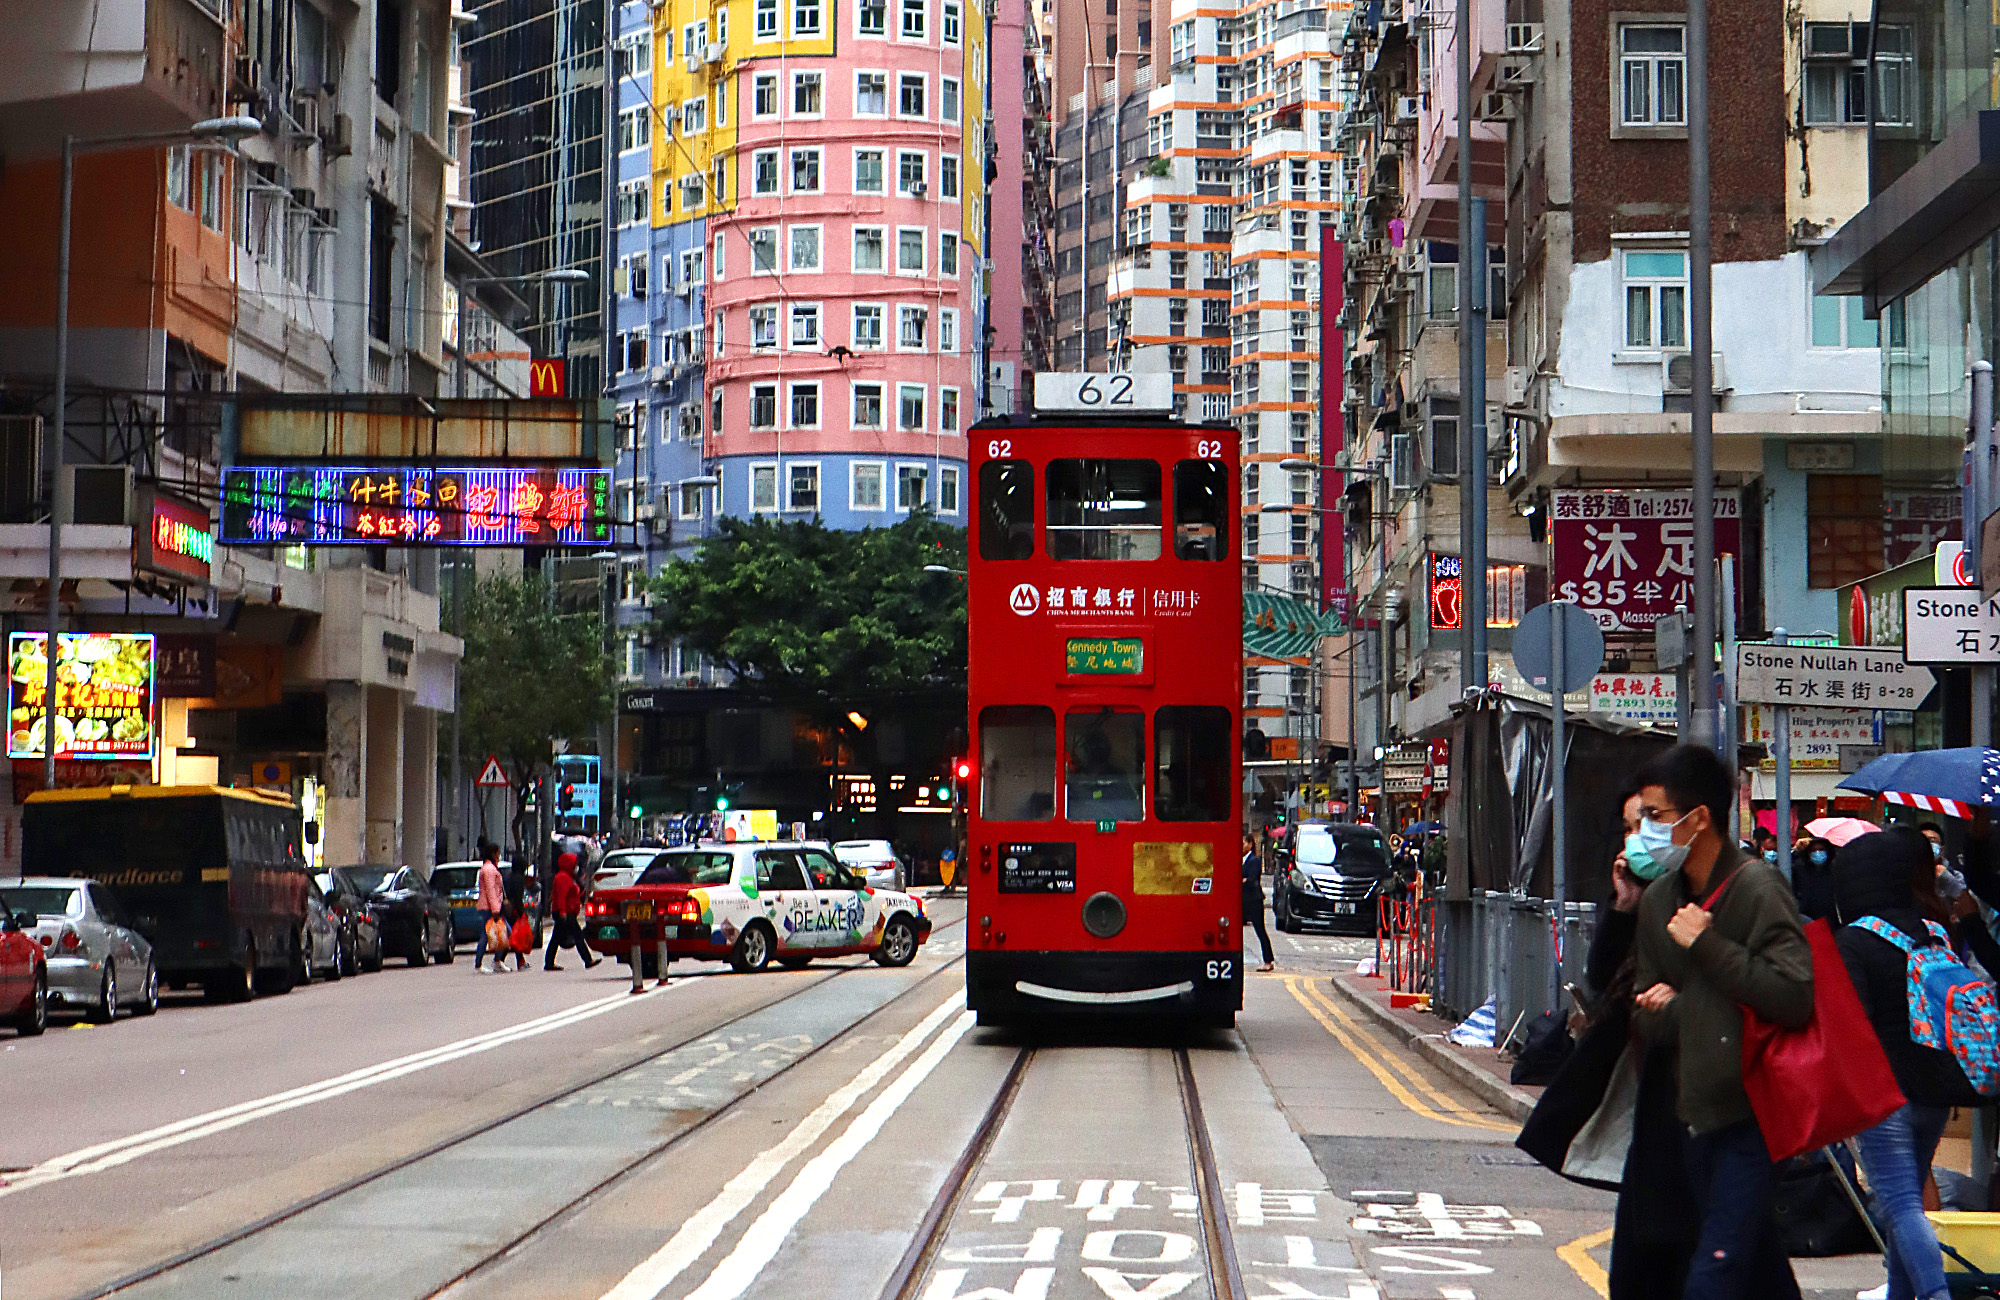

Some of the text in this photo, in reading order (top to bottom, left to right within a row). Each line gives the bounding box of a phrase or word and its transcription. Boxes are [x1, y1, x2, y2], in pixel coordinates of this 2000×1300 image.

[1078, 375, 1135, 406] 62
[988, 440, 1012, 458] 62
[1197, 440, 1222, 458] 62
[1556, 495, 1631, 517] 泰舒適
[1435, 556, 1460, 578] $98
[1047, 586, 1136, 608] 招商銀行
[1153, 589, 1201, 609] 信用卡
[1046, 609, 1135, 617] CHINA MERCHANTS BANK
[1154, 609, 1192, 617] Credit Card
[1917, 599, 1979, 617] Stone
[1067, 640, 1138, 655] Kennedy Town
[1744, 652, 1905, 674] Stone Nullah Lane
[1593, 676, 1663, 698] 和興地產
[1774, 678, 1914, 701] 石水渠街 8-28
[1616, 698, 1646, 708] 2893
[1792, 717, 1814, 727] Hing
[1816, 717, 1855, 727] Property
[1806, 743, 1832, 754] 2893
[1056, 880, 1074, 889] VISA
[793, 898, 802, 909] Be
[794, 909, 858, 932] PEAKER
[1207, 960, 1232, 979] 62
